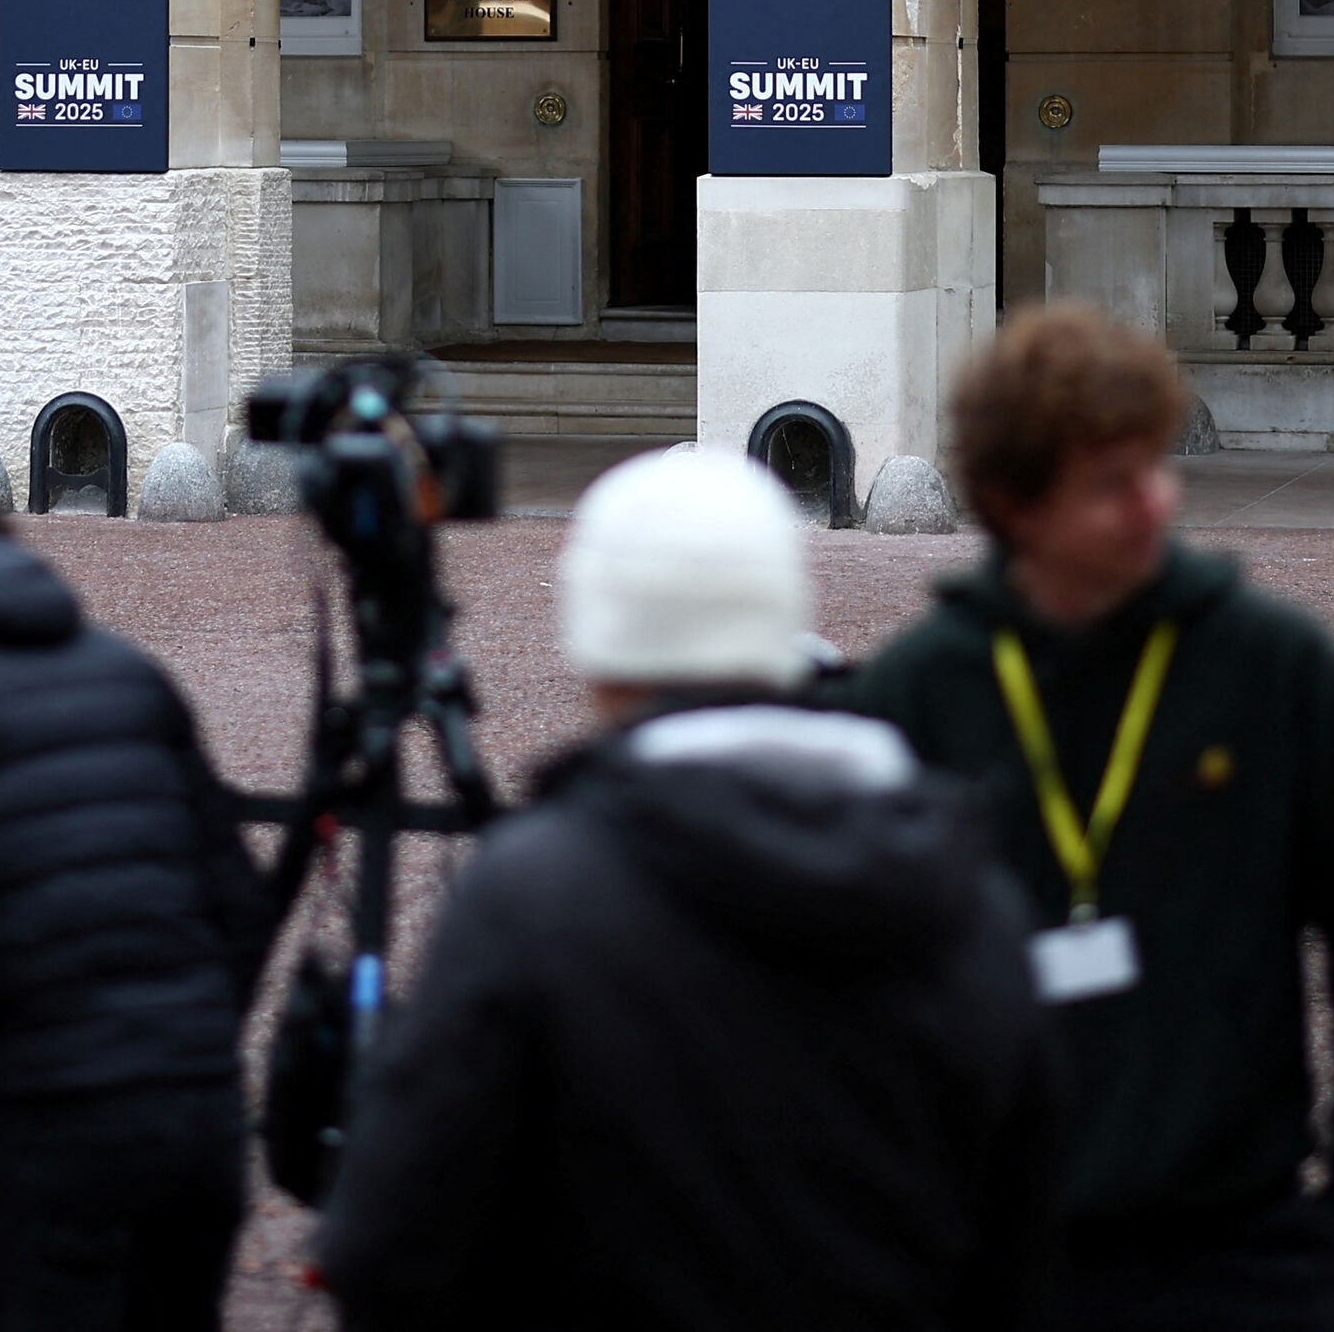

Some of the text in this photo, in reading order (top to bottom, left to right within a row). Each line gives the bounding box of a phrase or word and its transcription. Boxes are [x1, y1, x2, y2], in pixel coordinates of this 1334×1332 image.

[464, 6, 515, 19] HOUSE
[60, 59, 98, 70] UK-EU
[778, 58, 818, 69] UK-EU
[15, 74, 144, 100] SUMMIT
[730, 72, 867, 100] SUMMIT
[55, 103, 103, 120] 2025
[773, 103, 824, 121] 2025
